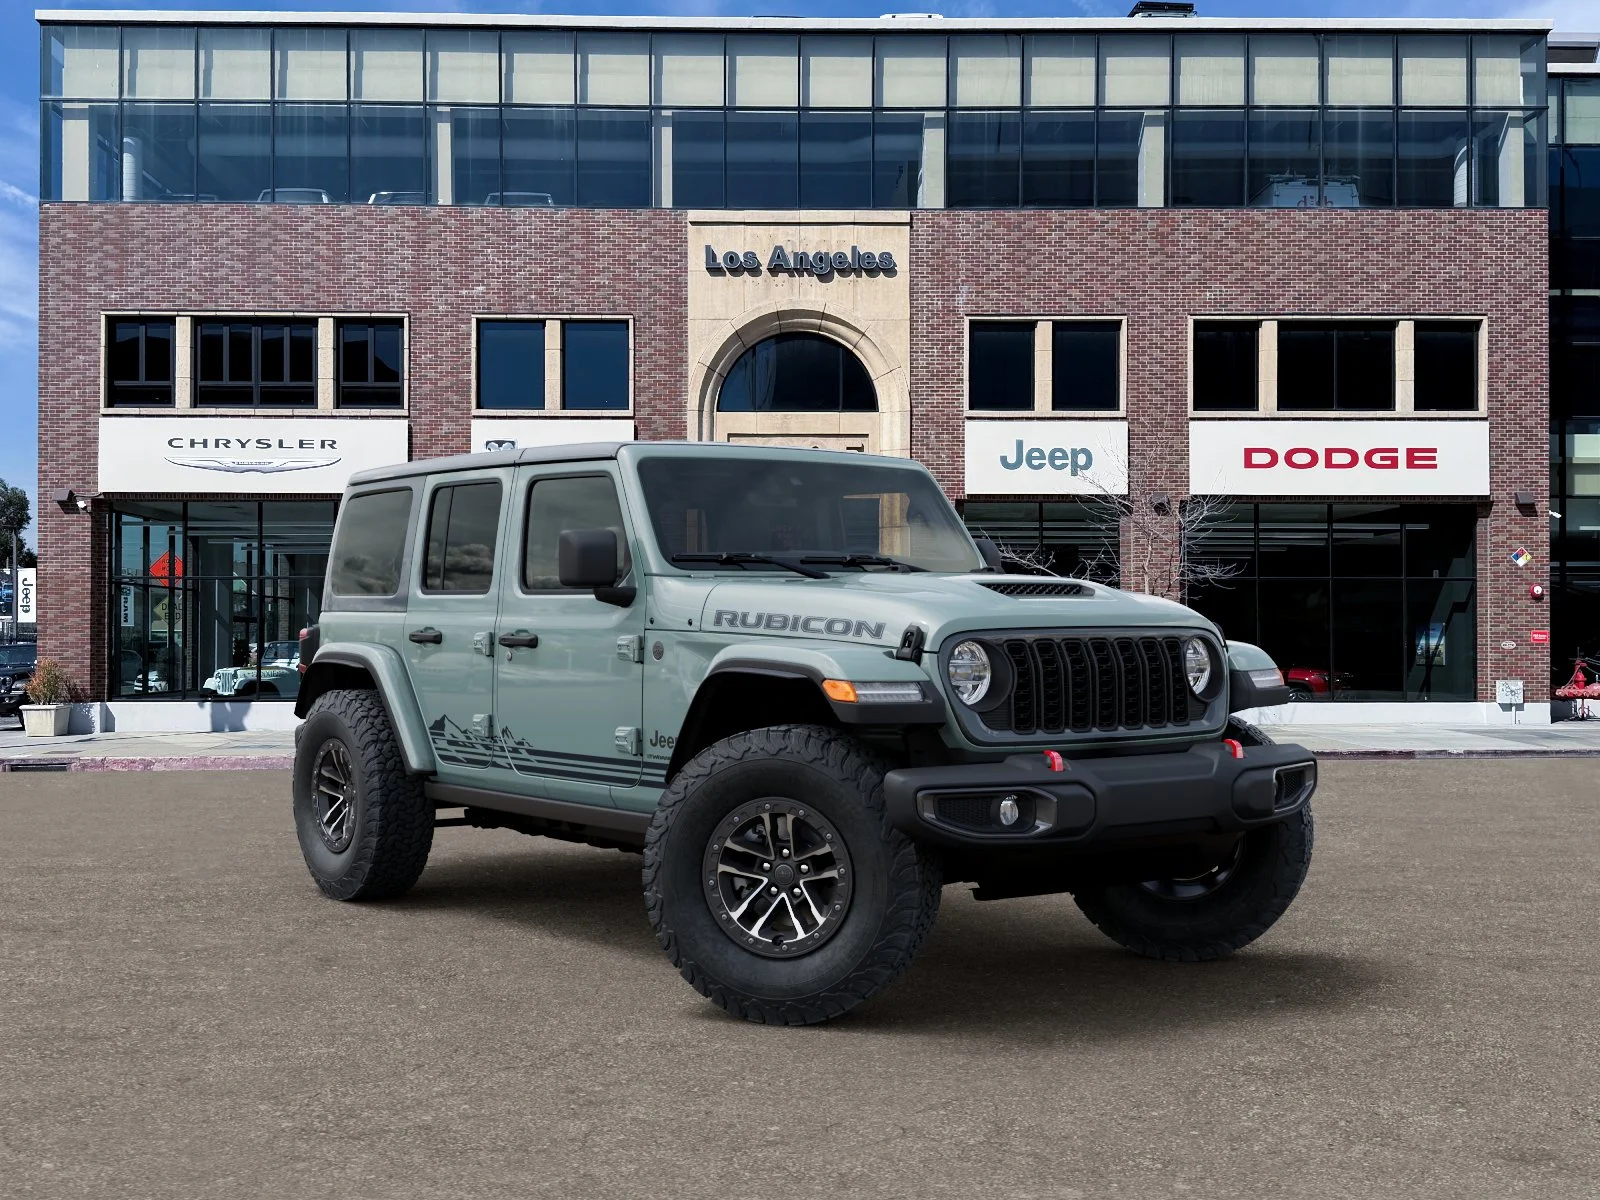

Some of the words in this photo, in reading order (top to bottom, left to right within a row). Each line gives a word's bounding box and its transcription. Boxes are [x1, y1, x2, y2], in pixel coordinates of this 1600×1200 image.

[705, 244, 758, 269] Los
[766, 244, 895, 275] Angeles
[167, 437, 338, 450] CHRYSLER
[1000, 438, 1094, 477] Jeep
[1243, 447, 1438, 470] DODGE
[20, 577, 34, 614] Jeep
[164, 612, 181, 620] ED
[713, 609, 887, 640] RUBICON
